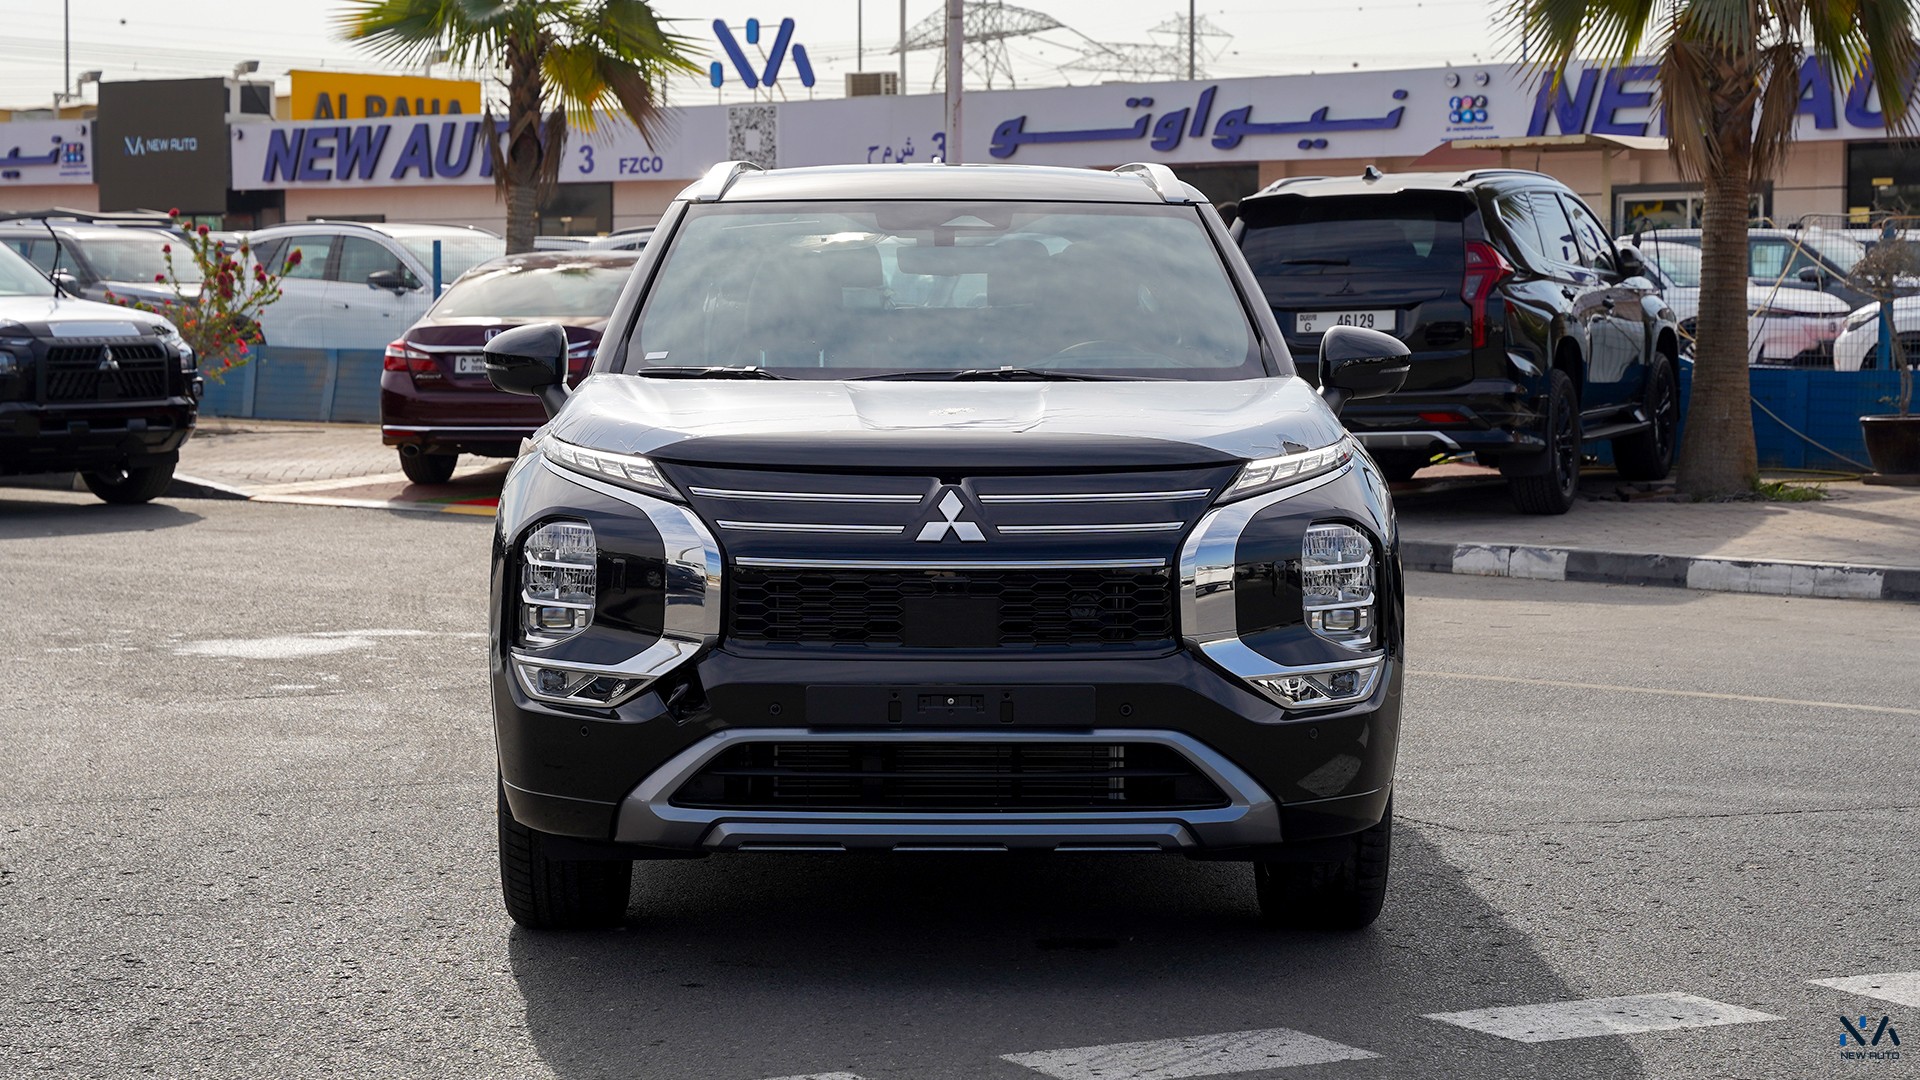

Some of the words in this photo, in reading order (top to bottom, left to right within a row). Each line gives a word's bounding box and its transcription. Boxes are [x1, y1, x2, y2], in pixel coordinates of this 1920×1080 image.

[1527, 65, 1668, 137] NE
[145, 138, 169, 152] NEW
[169, 137, 198, 152] AUTO
[262, 124, 391, 183] NEW
[390, 120, 552, 180] AUT
[578, 145, 595, 174] 3
[618, 156, 664, 175] FZCO
[1304, 322, 1312, 332] G
[1337, 313, 1374, 328] 46129
[460, 358, 466, 371] C
